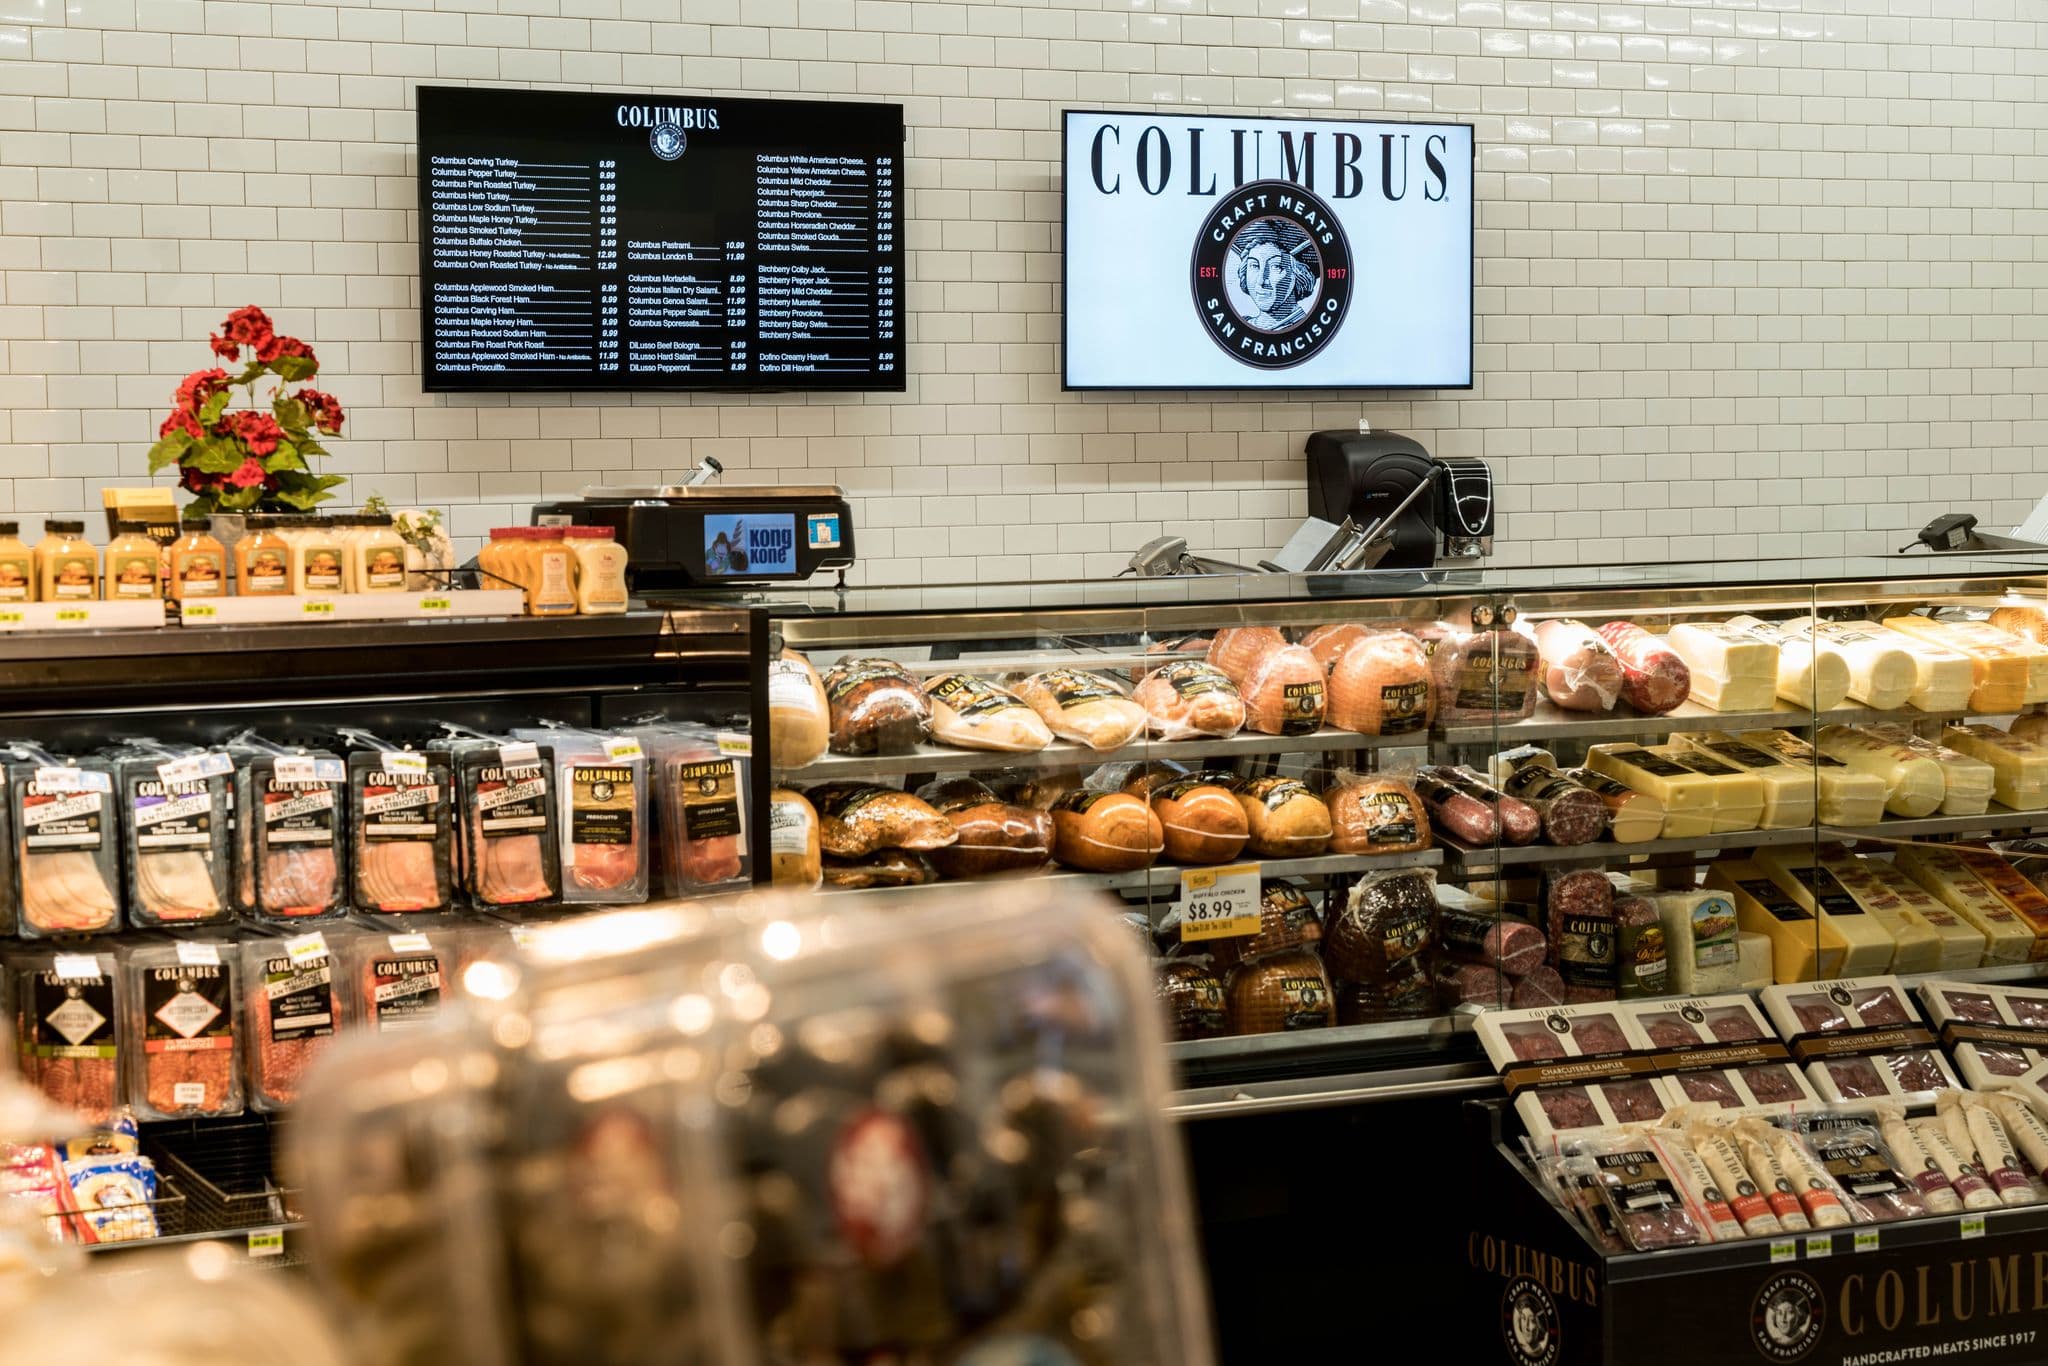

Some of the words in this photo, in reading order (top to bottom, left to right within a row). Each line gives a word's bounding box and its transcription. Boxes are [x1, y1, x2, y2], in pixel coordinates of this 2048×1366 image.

[618, 105, 718, 129] COLUMBUS
[431, 156, 466, 164] Columbus
[467, 158, 494, 167] Carving
[495, 158, 518, 167] Turkey
[1091, 124, 1447, 202] COLUMBUS
[431, 168, 467, 176] Columbus
[468, 169, 493, 178] Pepper
[494, 170, 517, 179] Turkey
[468, 180, 483, 188] Pan
[484, 181, 512, 189] Roasted
[513, 181, 536, 191] Turkey
[432, 214, 468, 222] Columbus
[468, 215, 490, 223] Maple
[491, 216, 513, 224] Honey
[514, 216, 538, 225] Turkey
[1213, 195, 1269, 243] CRAFT
[1278, 194, 1334, 246] MEATS
[432, 237, 468, 245] Columbus
[494, 238, 522, 246] Chicken
[600, 239, 617, 247] 9.99
[661, 241, 691, 249] Pastrami
[791, 266, 809, 274] Colby
[1200, 266, 1218, 279] EST.
[1326, 268, 1346, 280] 1917
[434, 283, 469, 291] Columbus
[469, 284, 507, 292] Applewood
[508, 284, 537, 292] Smoked
[682, 286, 695, 295] Dry
[470, 307, 497, 315] Carving
[792, 320, 808, 329] Baby
[1206, 297, 1232, 338] SAN
[1240, 298, 1338, 358] FRANCISCO
[673, 342, 700, 350] Bologna
[657, 364, 690, 372] Pepperoni
[369, 772, 435, 786] COLUMBUS
[574, 769, 632, 782] COLUMBUS
[384, 790, 428, 802] WITHOUT
[494, 782, 535, 797] WITHOUT
[369, 798, 429, 812] ANTIBIOTICS
[484, 790, 538, 808] ANTIBIOTICS
[270, 802, 324, 818] ANTIBIOTICS
[1188, 900, 1232, 922] $8.99
[378, 960, 436, 976] COLUMBUS
[379, 982, 432, 998] ANTIBIOTICS
[1828, 1036, 1873, 1047] CHARCUTERIE
[1875, 1032, 1906, 1043] SAMPLER
[1680, 1050, 1728, 1061] CHARCUTERIE
[1729, 1048, 1760, 1057] SAMPLER
[1541, 1065, 1591, 1076] CHARCUTERIE
[1592, 1062, 1625, 1071] SAMPLER
[1604, 1152, 1652, 1166] COLUMBUS
[1468, 1232, 1598, 1307] COLUMBUS
[1760, 1278, 1786, 1305] CRAFT
[1790, 1276, 1816, 1300] MEATS
[1757, 1330, 1772, 1351] SAN
[1774, 1323, 1820, 1357] FRANCISCO
[1843, 1346, 1930, 1366] HANDCRAFTED
[1932, 1340, 1970, 1356] MEATS
[1972, 1336, 2007, 1350] SINCE
[2010, 1331, 2036, 1346] 1917
